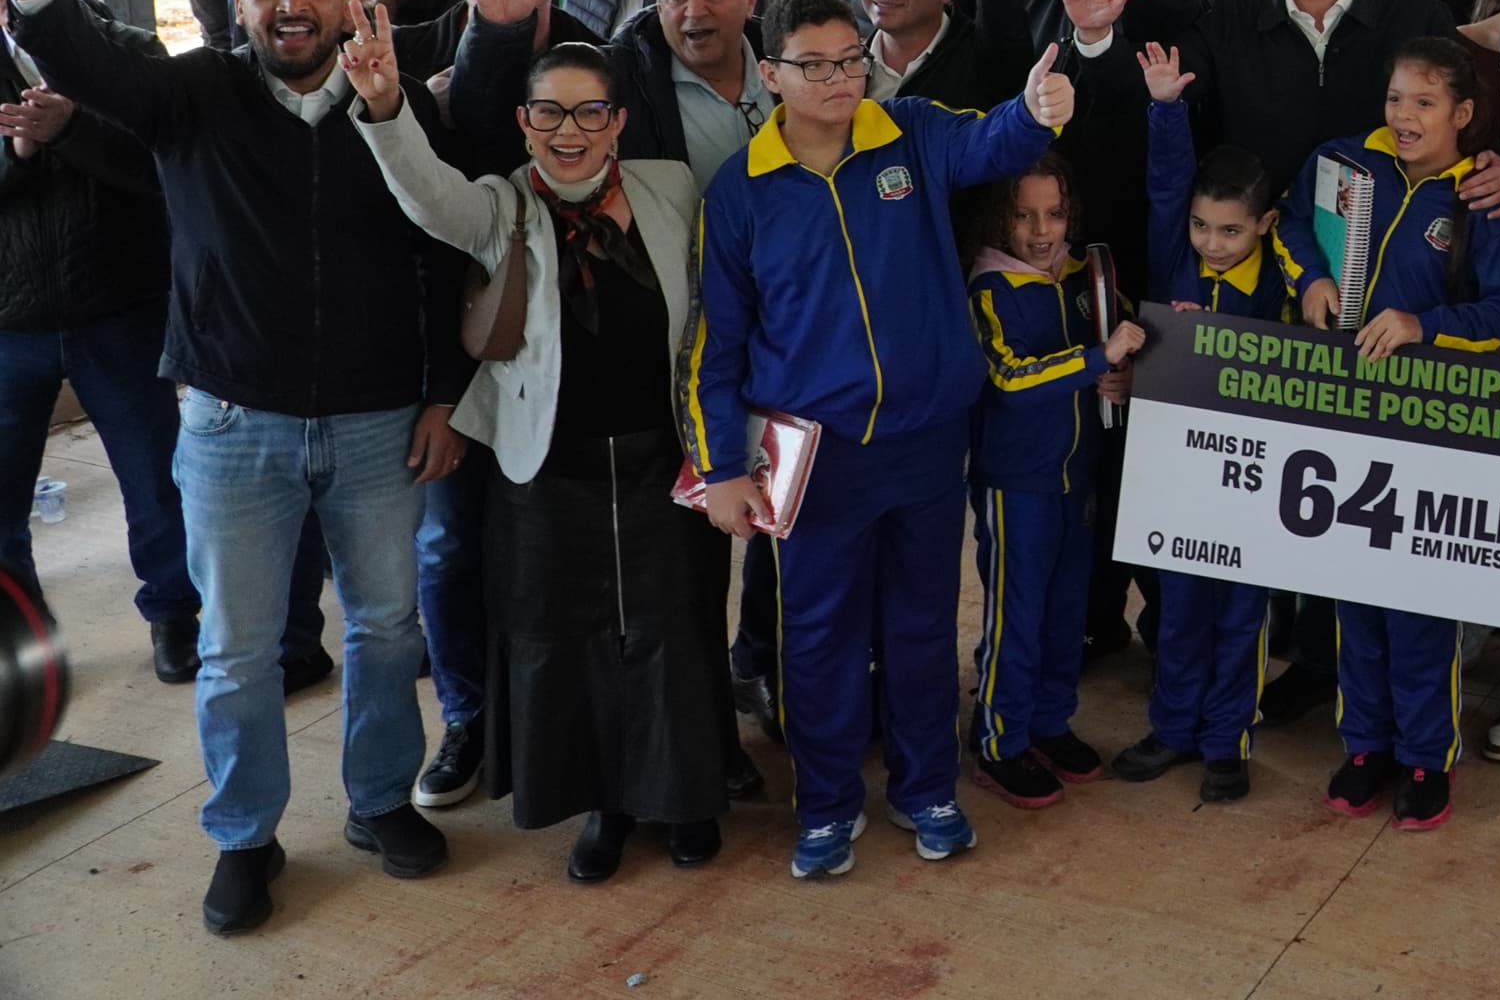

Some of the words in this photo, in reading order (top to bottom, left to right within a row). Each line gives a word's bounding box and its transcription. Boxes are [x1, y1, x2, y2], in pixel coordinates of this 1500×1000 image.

[1194, 324, 1348, 376] HOSPITAL
[1218, 367, 1371, 419] GRACIELE
[1186, 429, 1238, 454] MAIS
[1241, 438, 1267, 459] DE
[1222, 460, 1263, 494] R$
[1279, 449, 1405, 551] 64
[1171, 537, 1242, 569] GUAÍRA
[1411, 536, 1443, 559] EM
